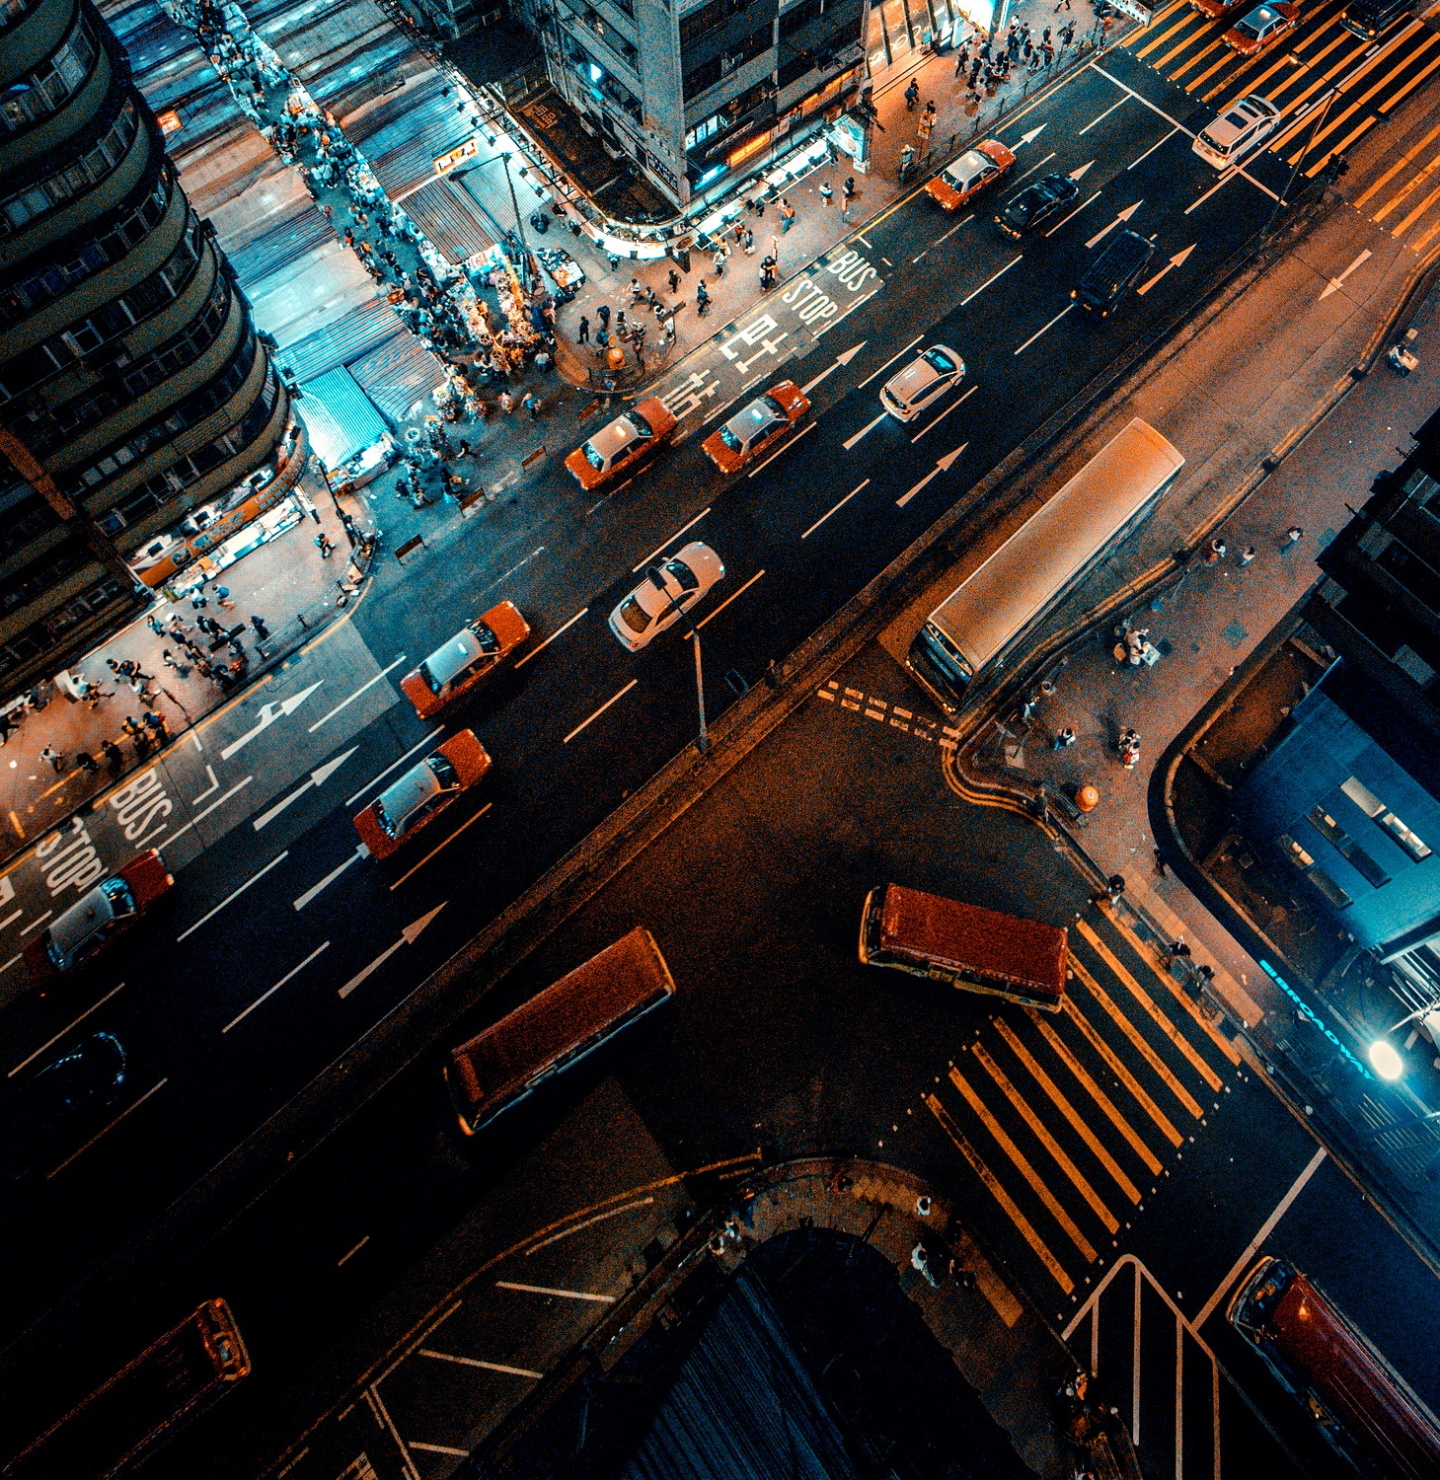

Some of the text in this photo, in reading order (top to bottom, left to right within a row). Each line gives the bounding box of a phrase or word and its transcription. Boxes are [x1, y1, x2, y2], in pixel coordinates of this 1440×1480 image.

[782, 279, 838, 326] STOP
[827, 249, 877, 292] BUS
[719, 313, 788, 374] 巴士
[109, 767, 173, 841] BUS
[35, 816, 104, 898] STOP
[1275, 976, 1376, 1081] BROADWAY
